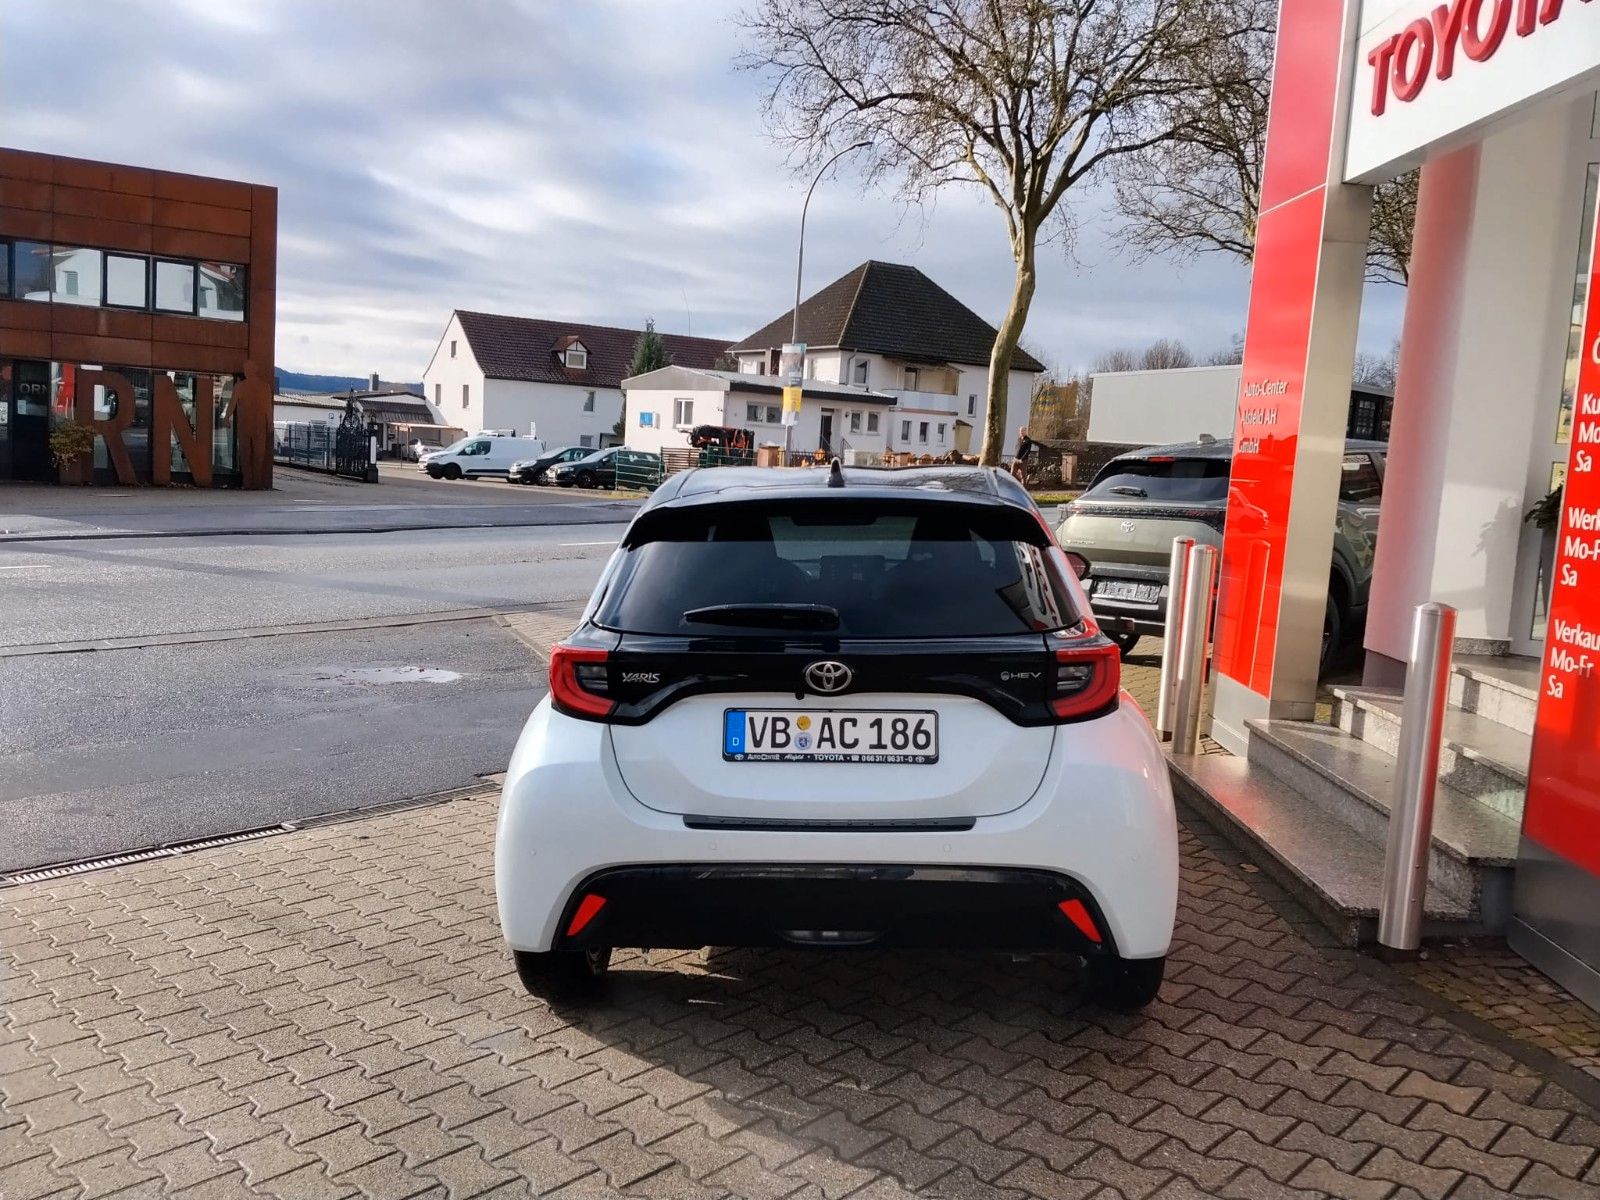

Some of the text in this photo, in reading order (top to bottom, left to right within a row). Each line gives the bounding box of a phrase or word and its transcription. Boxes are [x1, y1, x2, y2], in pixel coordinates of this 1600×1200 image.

[1368, 0, 1592, 117] TOYO
[1574, 450, 1592, 472] Sa
[1560, 563, 1578, 587] Sa
[1554, 618, 1600, 651] Verkau
[1550, 646, 1595, 678] Mo-Fr
[622, 672, 660, 683] YARIS
[1546, 674, 1563, 699] Sa
[732, 738, 740, 746] D
[749, 716, 932, 750] VB AC 186
[814, 754, 845, 762] TOYOTA
